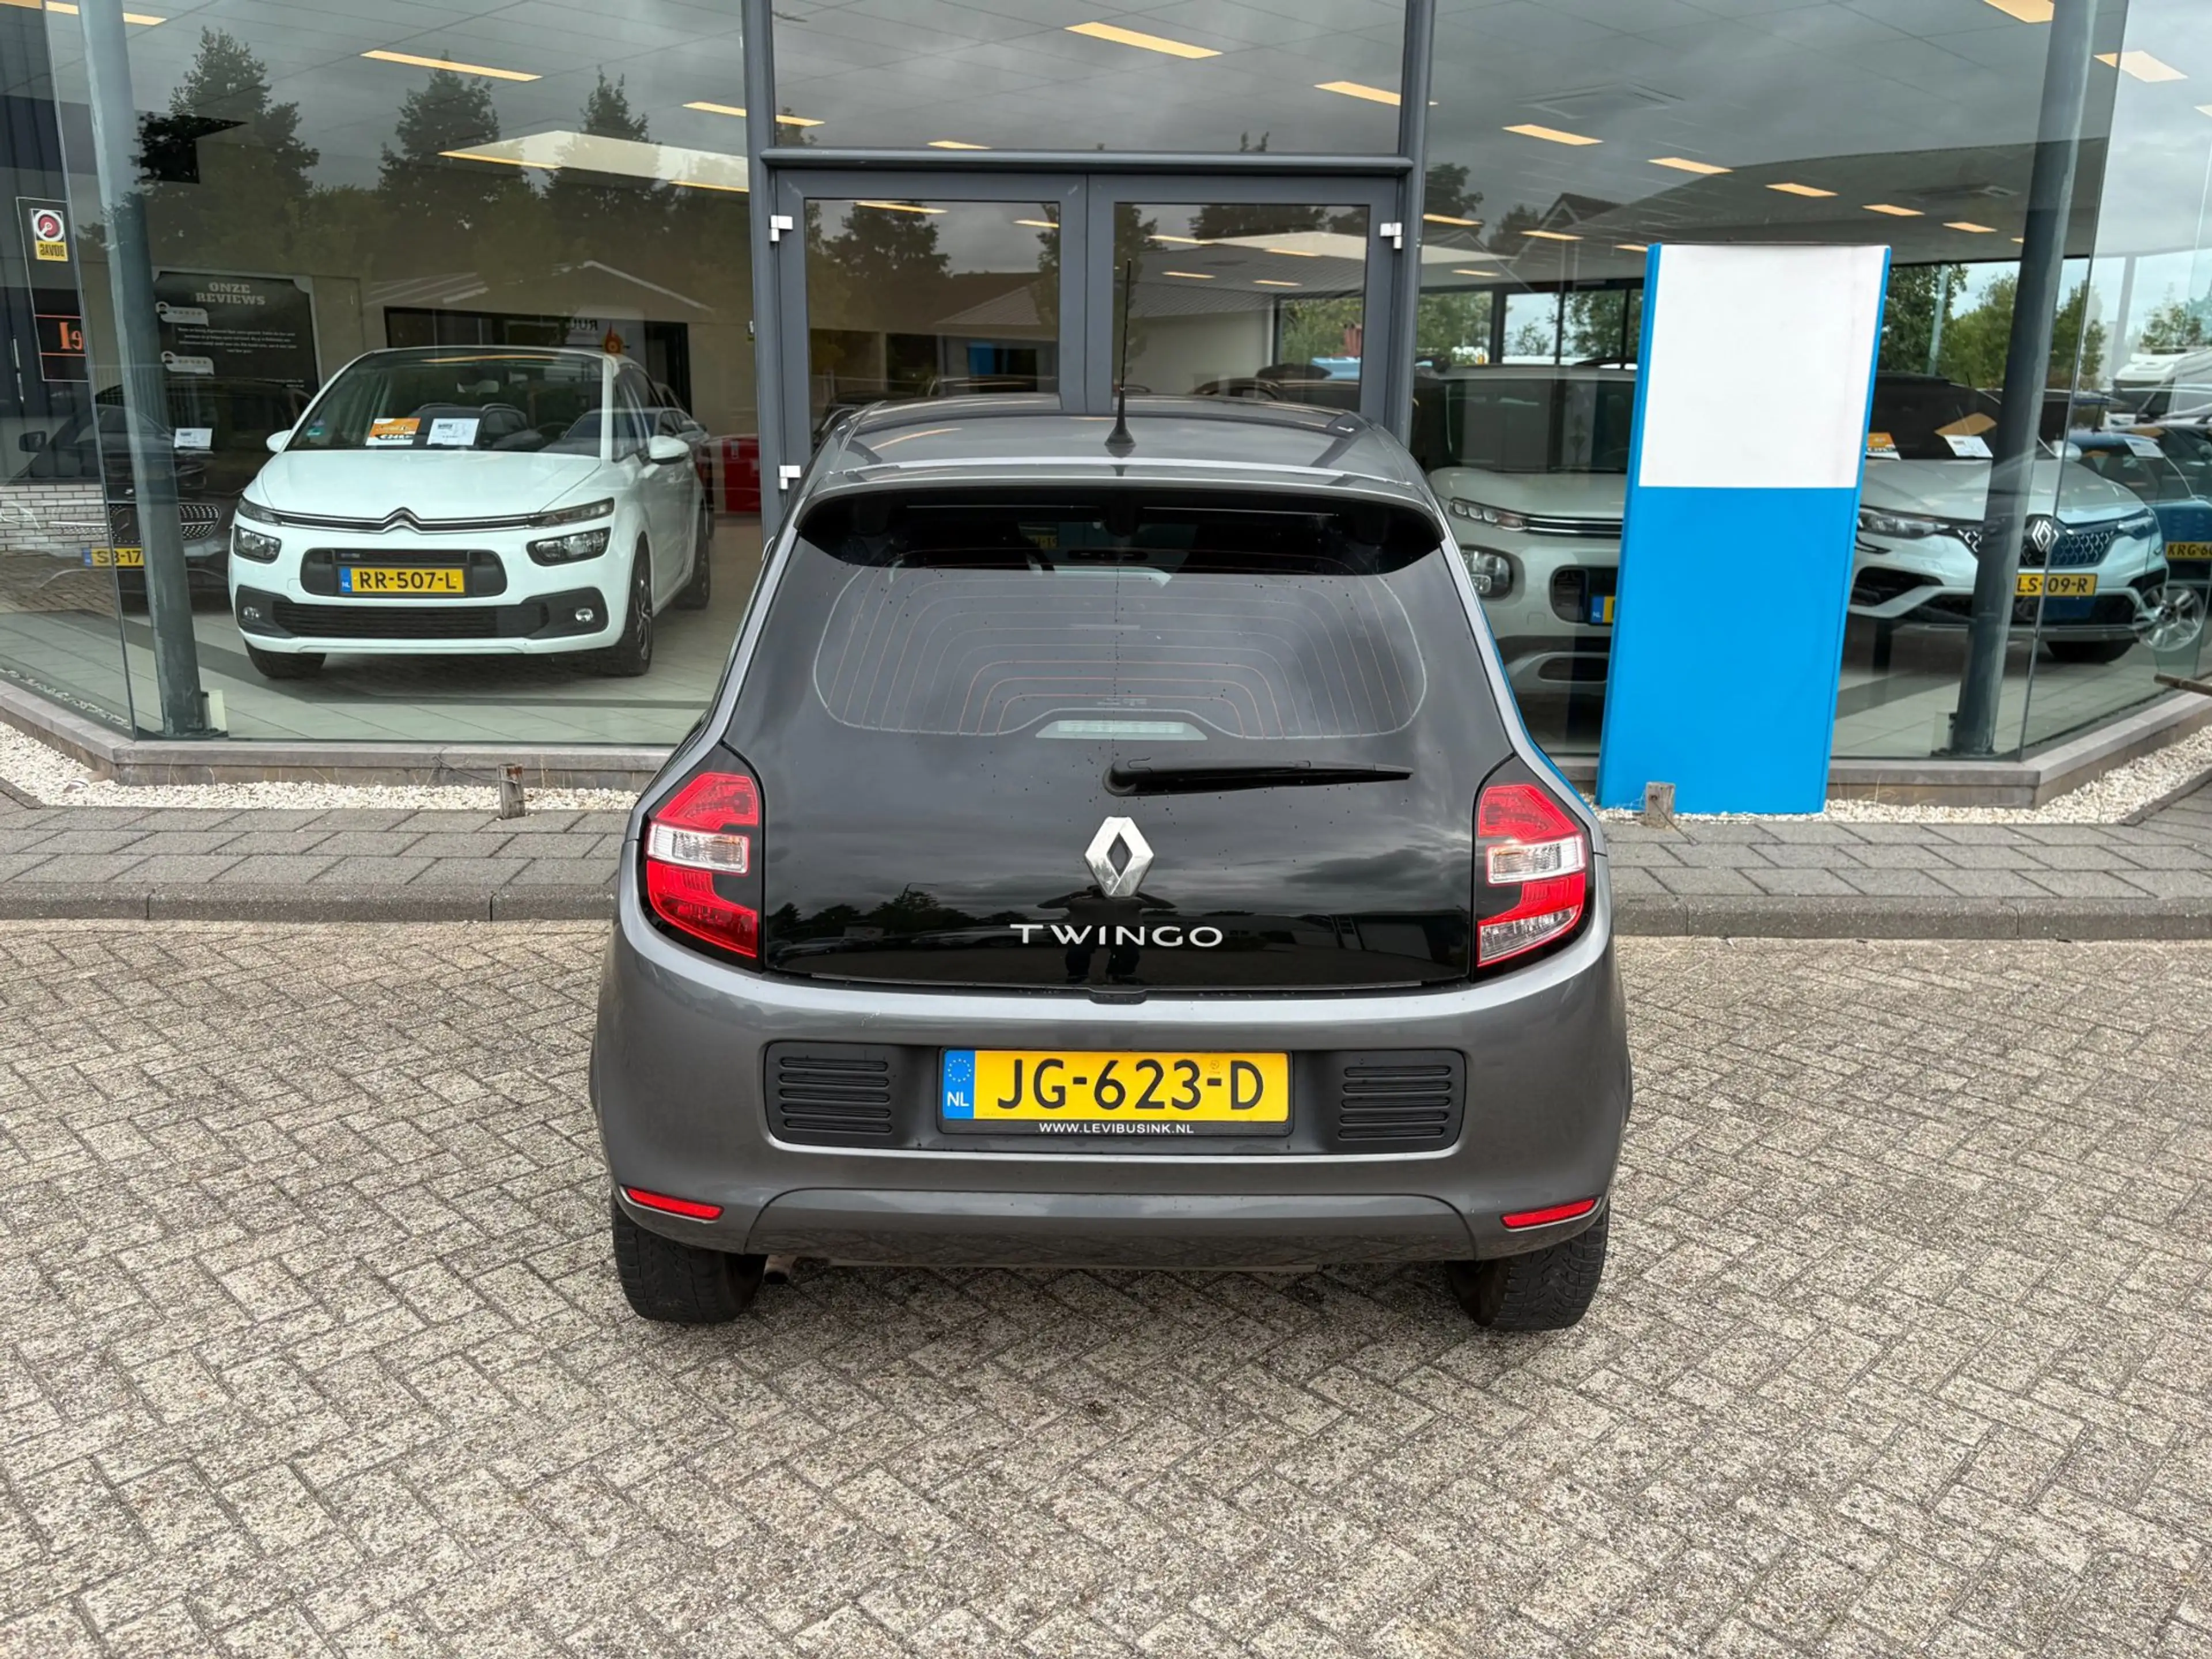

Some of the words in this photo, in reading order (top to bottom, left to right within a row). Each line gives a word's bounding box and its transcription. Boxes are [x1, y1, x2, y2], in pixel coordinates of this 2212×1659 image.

[208, 282, 251, 294] ONZE
[195, 292, 266, 305] REVIEWS
[359, 571, 457, 589] RR-507-L
[1010, 923, 1223, 948] TWINGO
[997, 1058, 1264, 1110] JG-623-D
[946, 1091, 969, 1107] NL
[1039, 1123, 1194, 1134] WWW.LEVIBUSINK.NL
